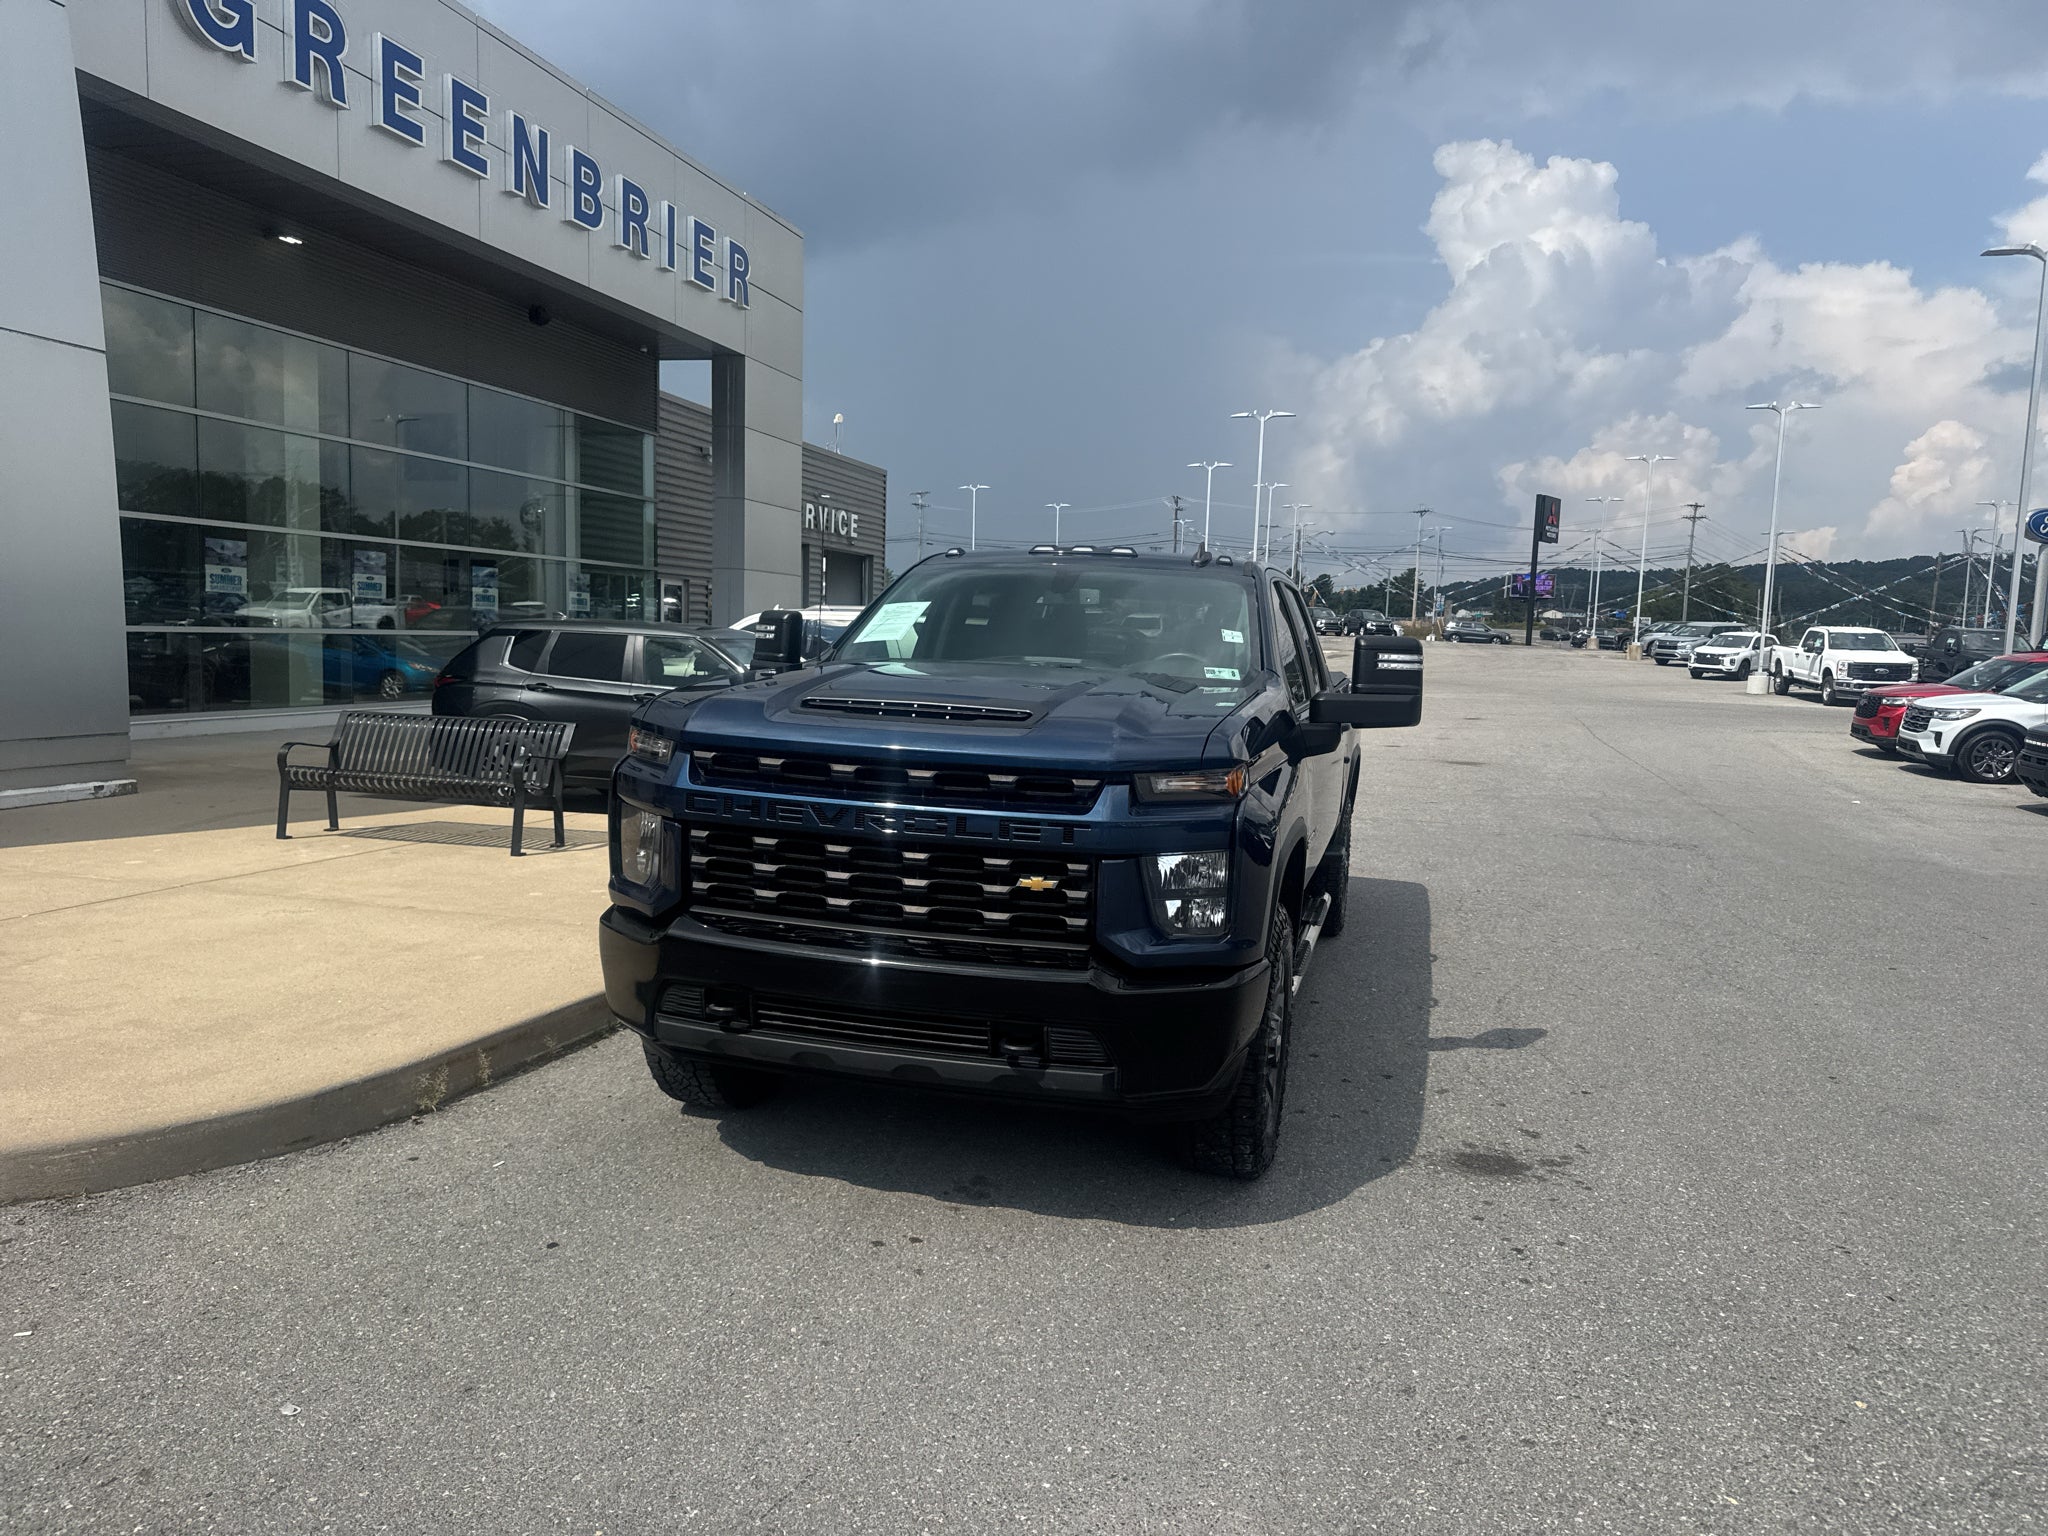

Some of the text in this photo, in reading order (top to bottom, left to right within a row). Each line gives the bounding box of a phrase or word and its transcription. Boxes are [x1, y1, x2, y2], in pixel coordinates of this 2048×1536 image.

[805, 503, 859, 538] RVICE
[209, 573, 243, 586] SUMMER
[685, 792, 1092, 845] CHEVROLET
